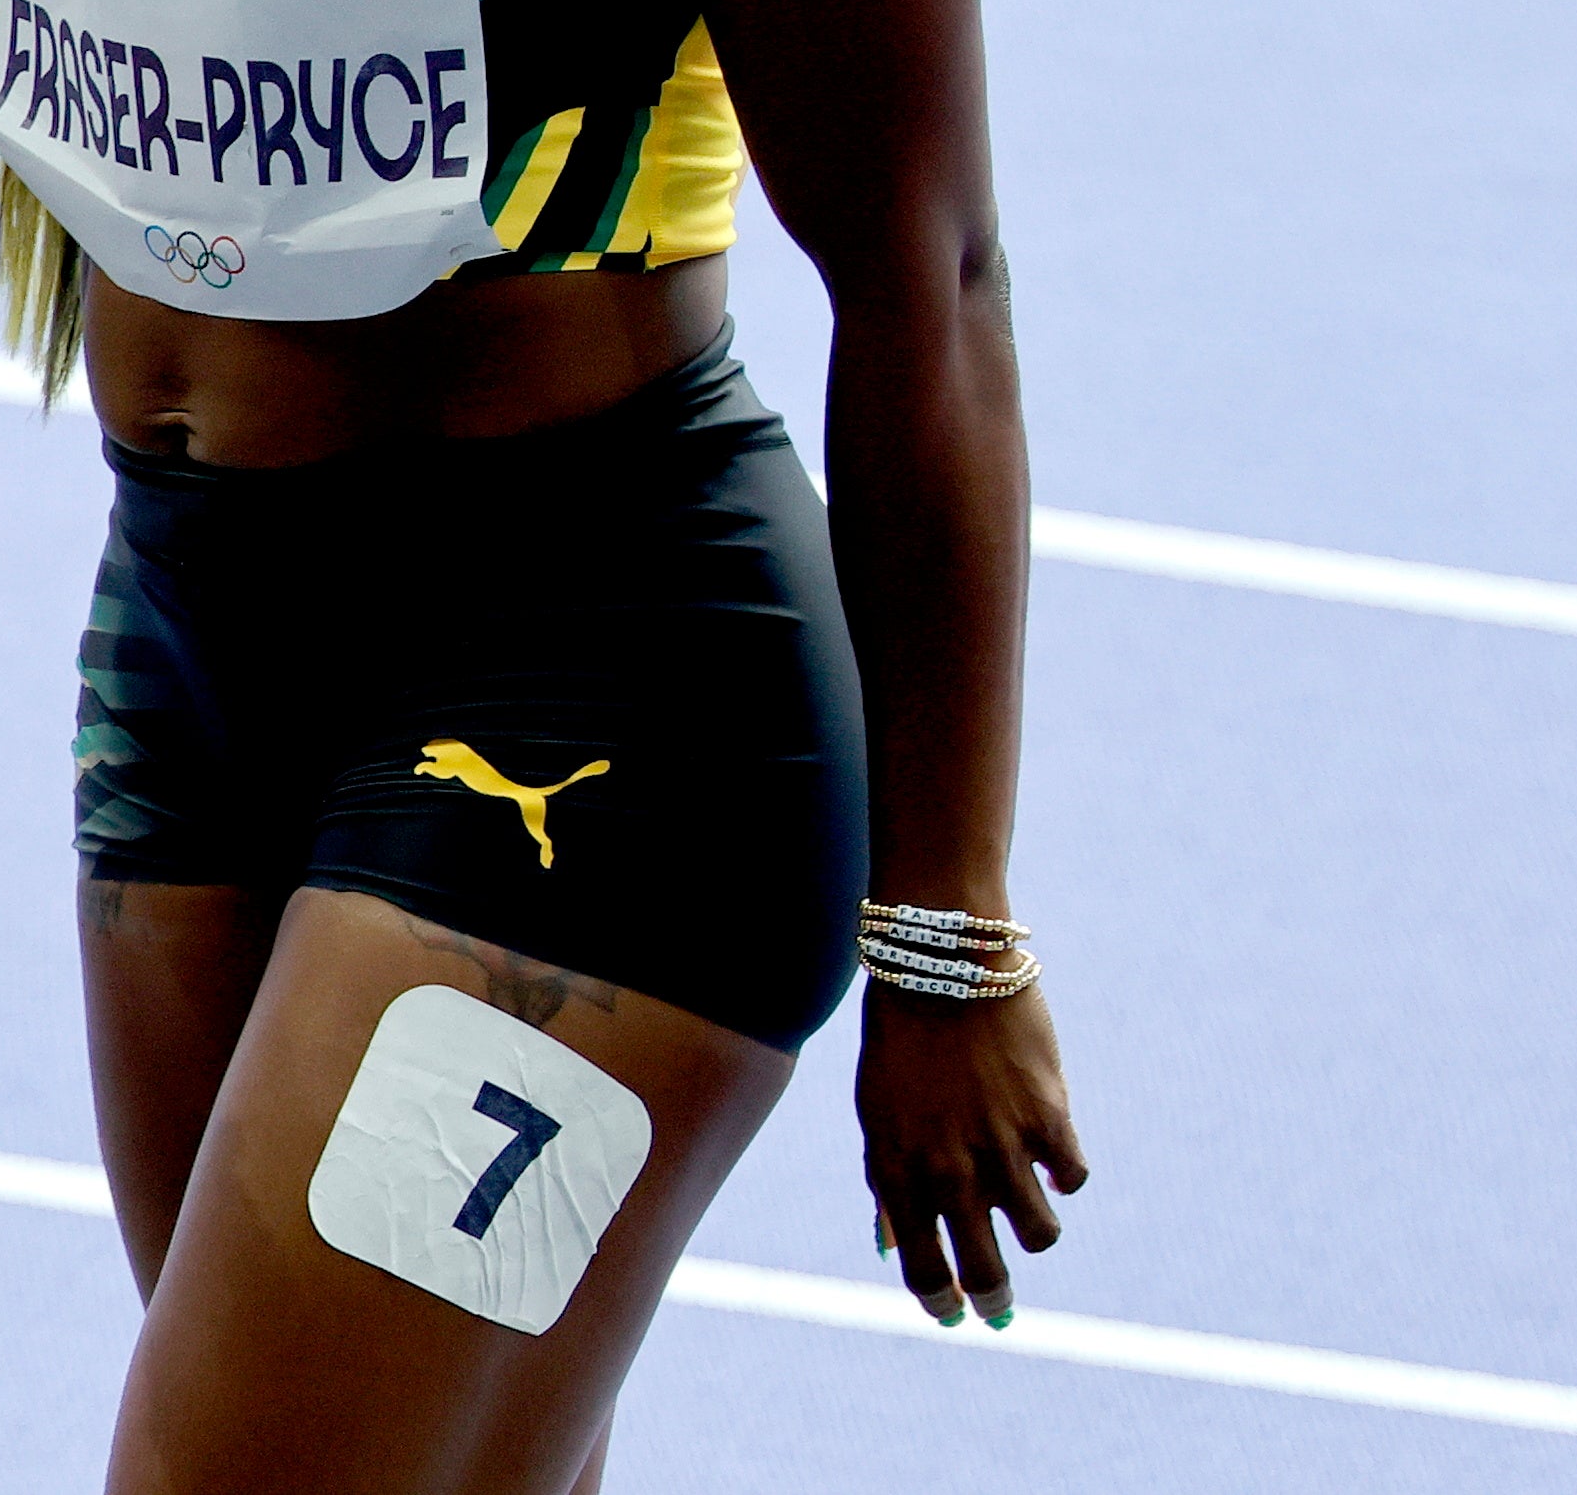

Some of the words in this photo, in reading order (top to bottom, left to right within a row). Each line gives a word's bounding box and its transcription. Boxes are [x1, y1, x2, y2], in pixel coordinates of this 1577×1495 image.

[898, 906, 963, 928] FAITH
[901, 977, 966, 995] FOCUS
[451, 1080, 562, 1240] 7
